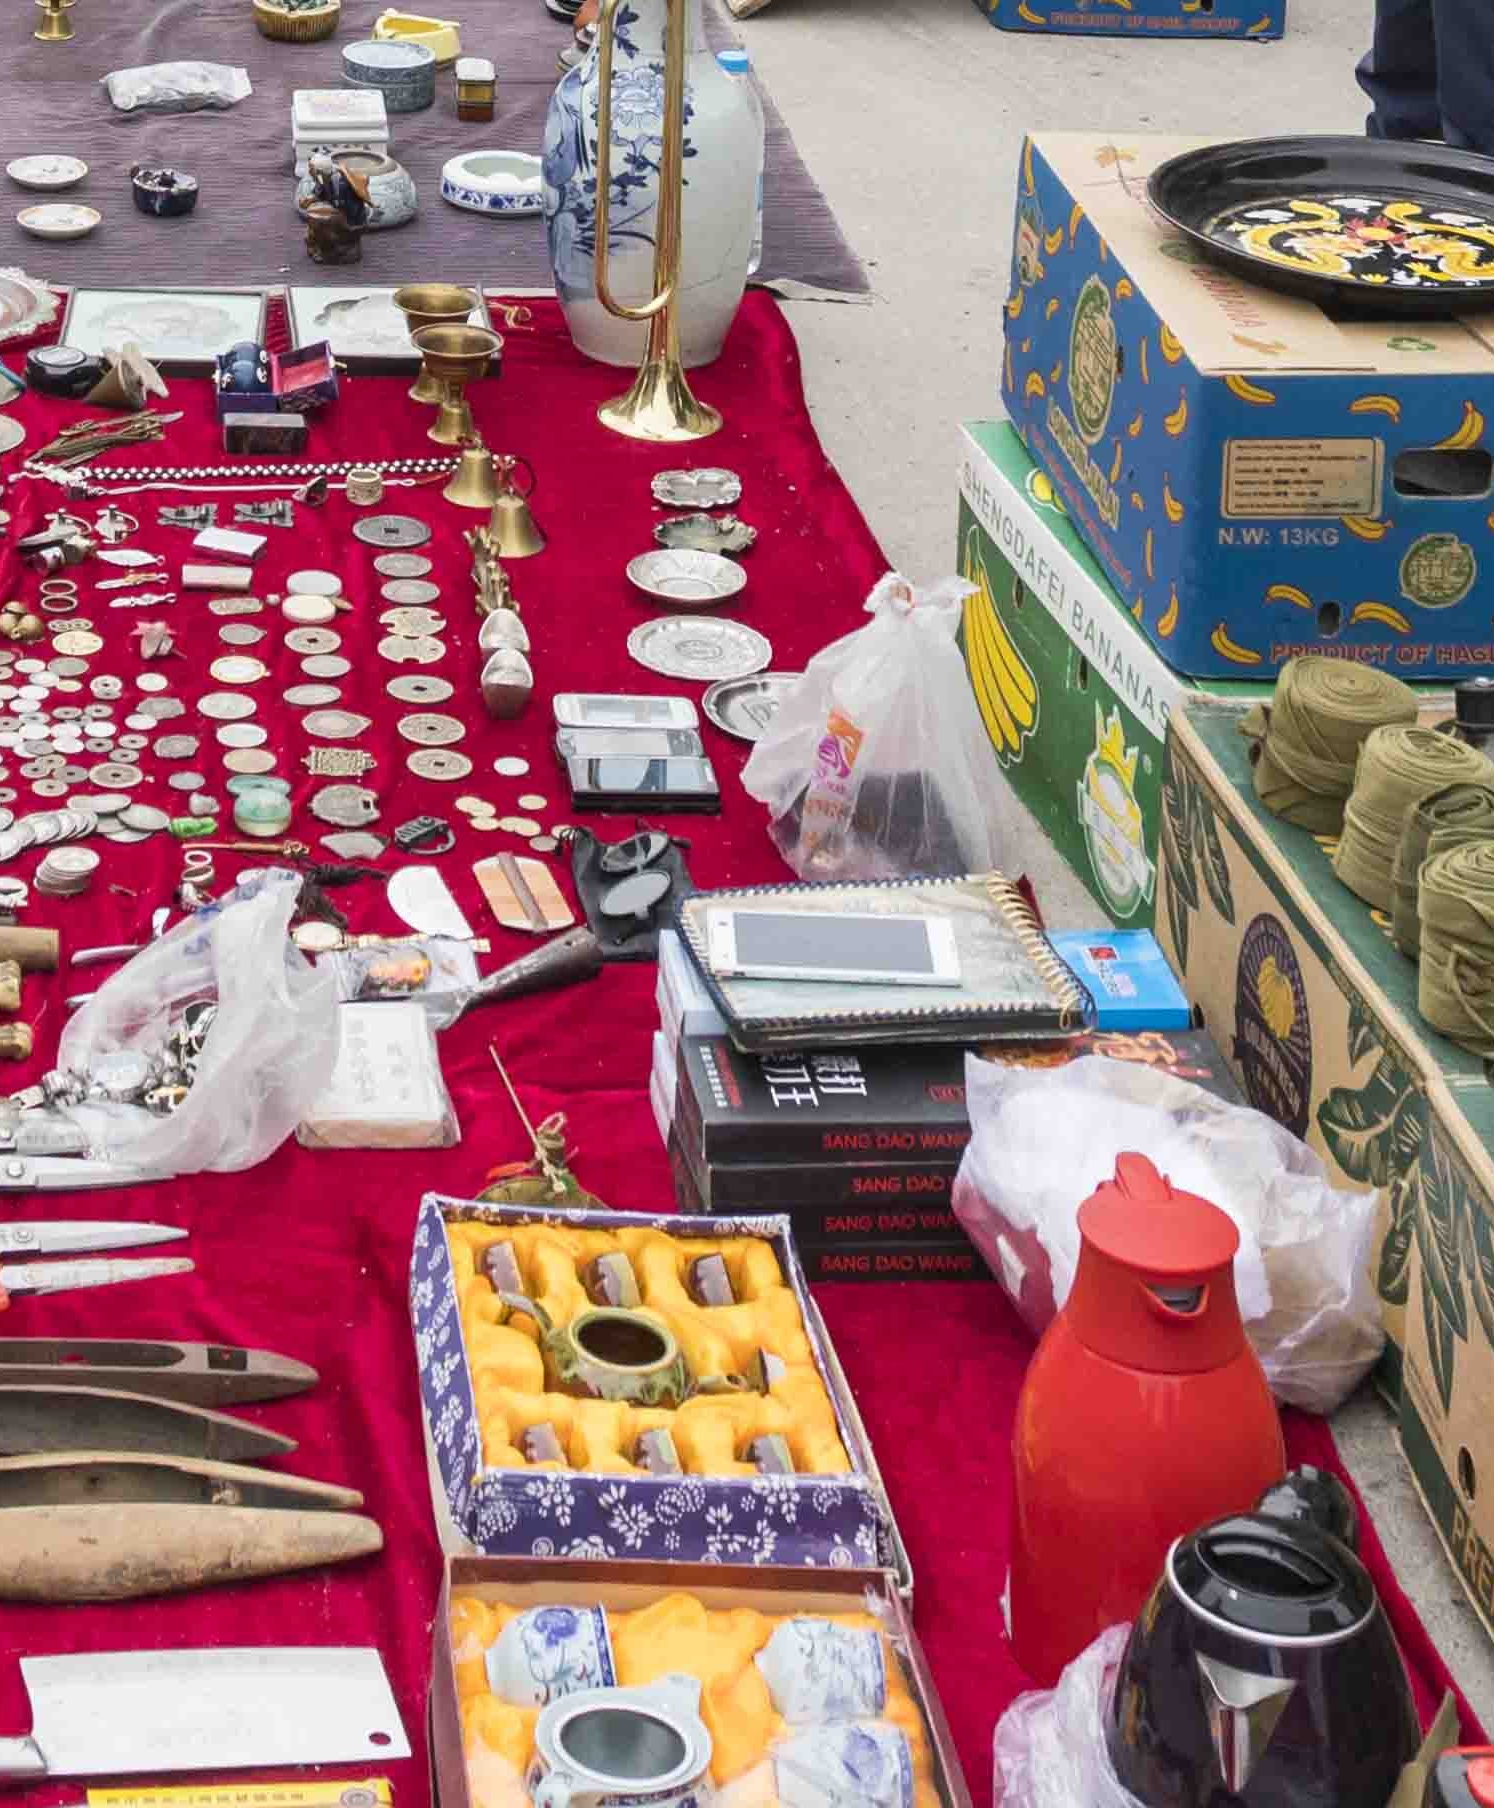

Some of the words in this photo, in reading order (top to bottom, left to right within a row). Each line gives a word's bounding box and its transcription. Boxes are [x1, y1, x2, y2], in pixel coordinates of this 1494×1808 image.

[1279, 527, 1340, 545] 13KG
[961, 462, 1066, 610] SHENGDAFEI
[1071, 600, 1171, 729] BANANAS
[1395, 642, 1434, 665] OF
